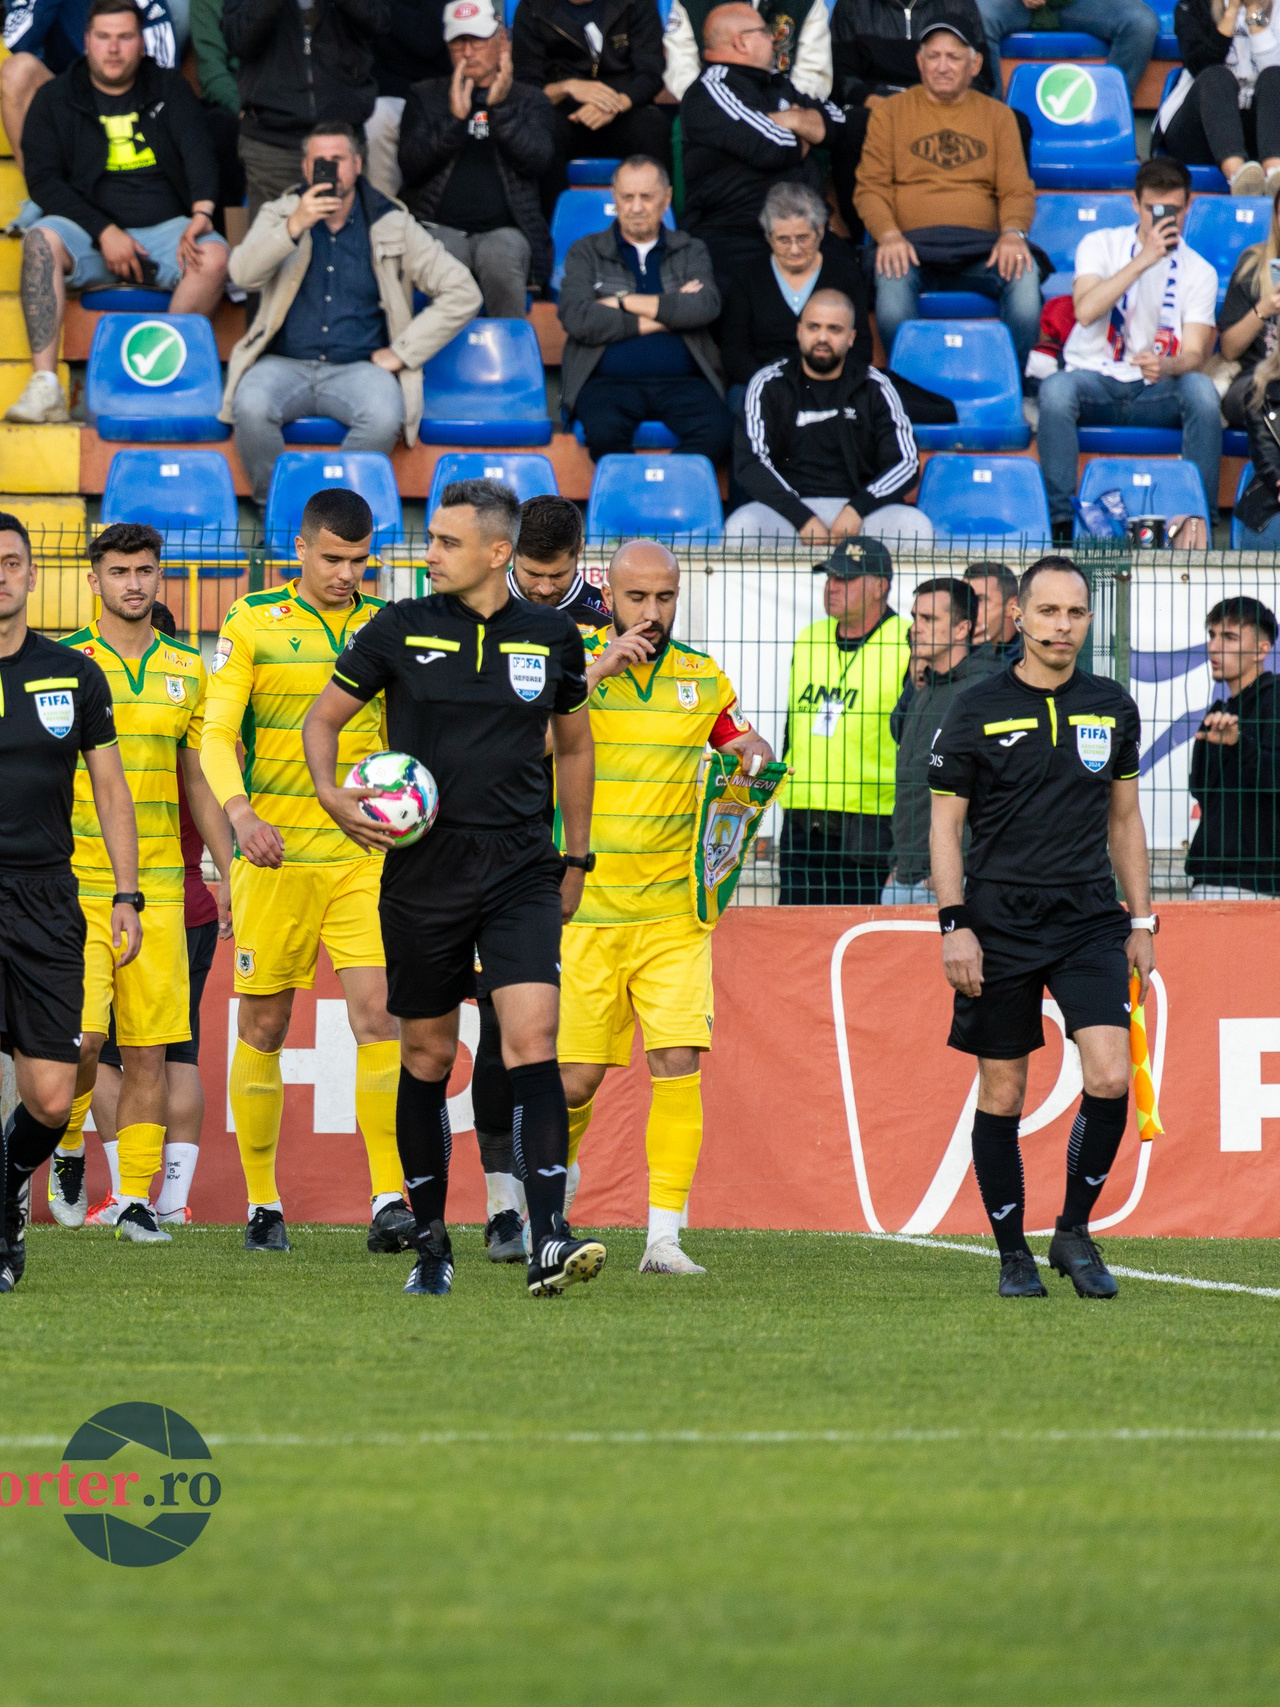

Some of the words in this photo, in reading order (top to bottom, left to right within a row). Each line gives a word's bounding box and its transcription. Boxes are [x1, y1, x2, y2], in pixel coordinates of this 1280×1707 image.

[513, 657, 542, 669] FIFA
[39, 695, 70, 707] FIFA
[1081, 728, 1107, 739] FIFA
